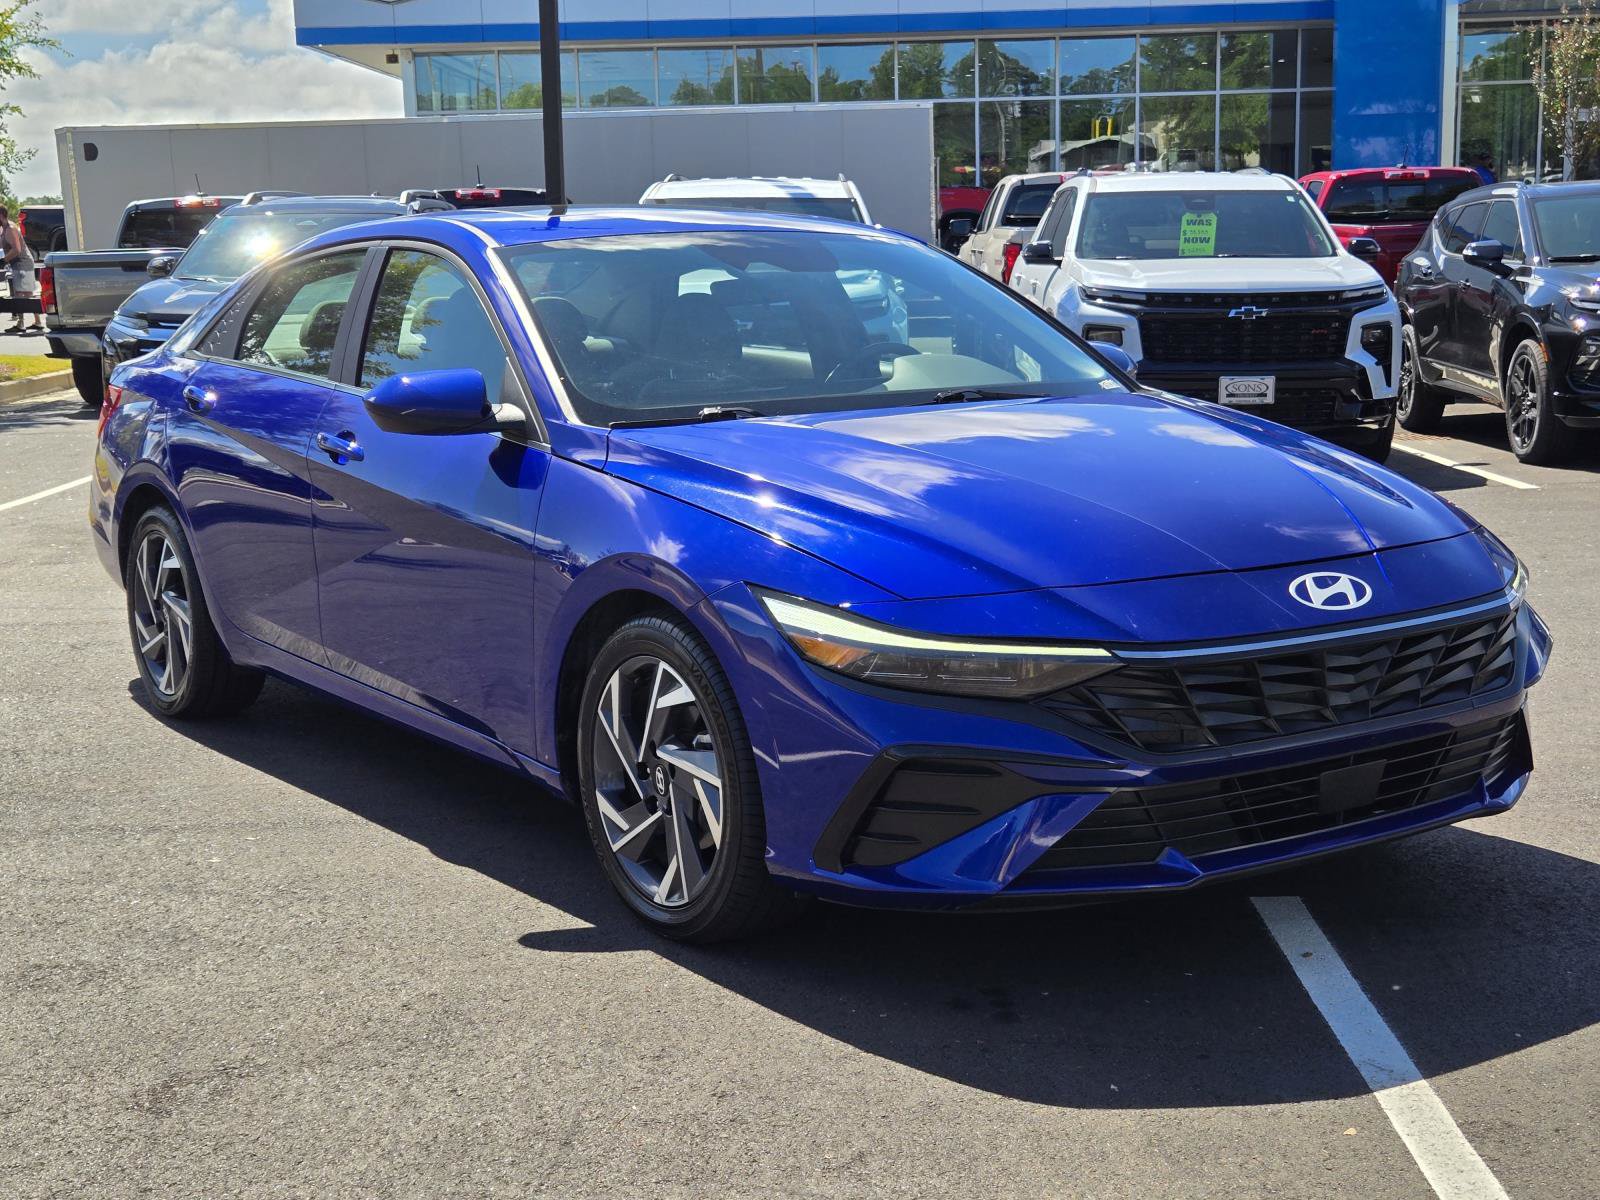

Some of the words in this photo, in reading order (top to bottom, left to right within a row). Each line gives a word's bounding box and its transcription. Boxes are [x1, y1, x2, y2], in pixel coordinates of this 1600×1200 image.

[1186, 218, 1213, 226] WAS
[1183, 236, 1211, 244] NOW
[1231, 383, 1263, 393] SONS
